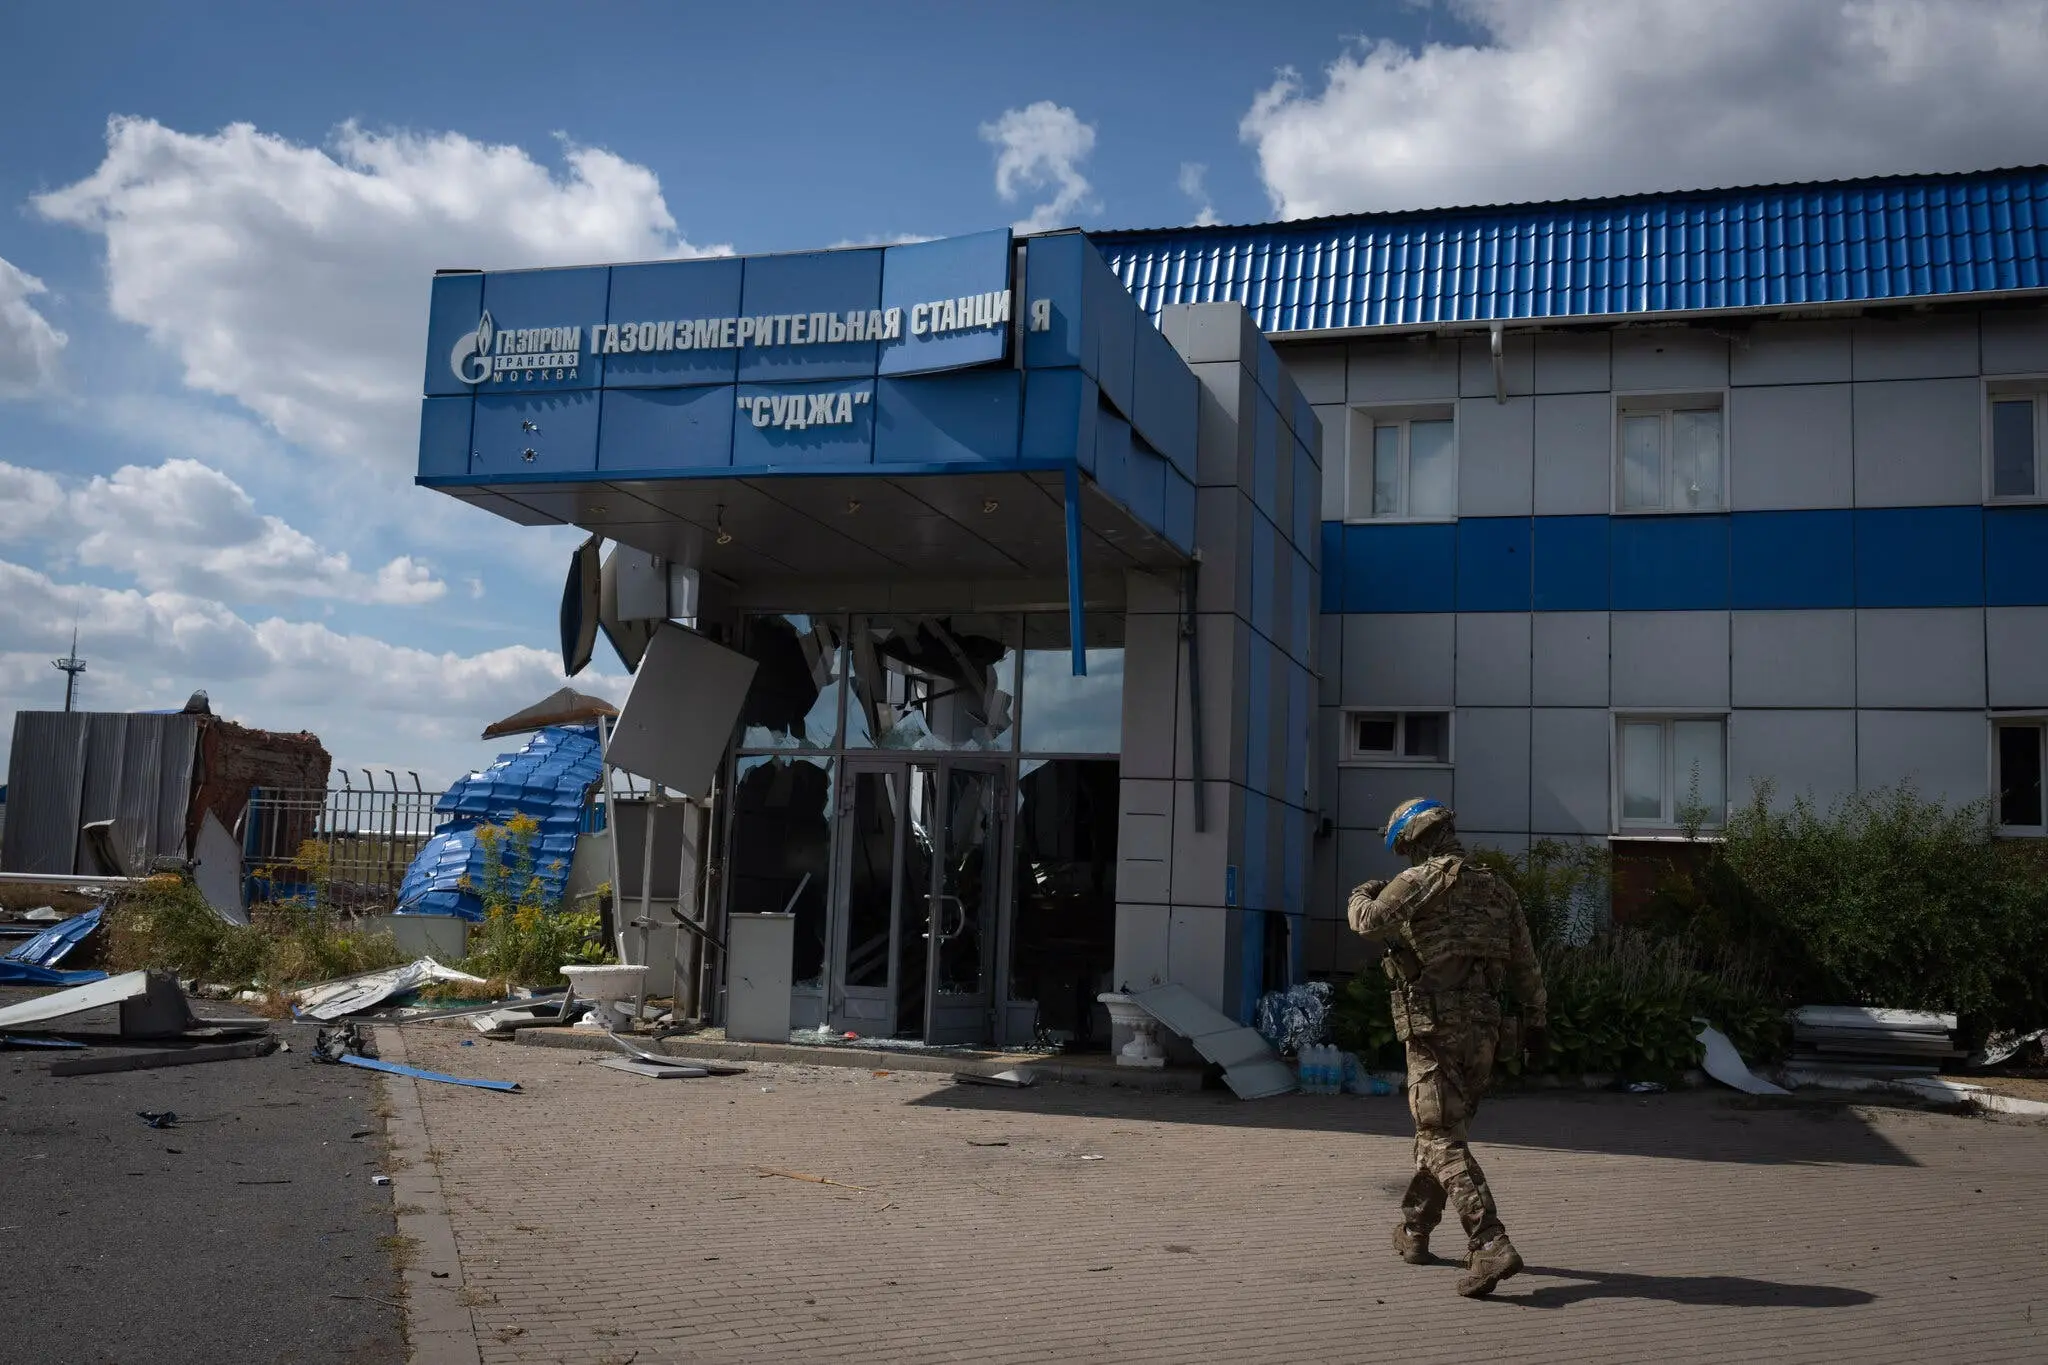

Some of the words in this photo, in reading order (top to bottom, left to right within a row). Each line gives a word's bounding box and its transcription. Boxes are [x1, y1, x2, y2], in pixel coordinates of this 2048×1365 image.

[495, 326, 581, 354] ГАЗПРОМ
[590, 307, 901, 355] ГАЗОИЗМЕРИТЕЛЬНАЯ
[493, 367, 578, 383] МОСКВА
[496, 354, 576, 368] ТРАНСГАЗ
[737, 391, 870, 430] "СУДЖА"
